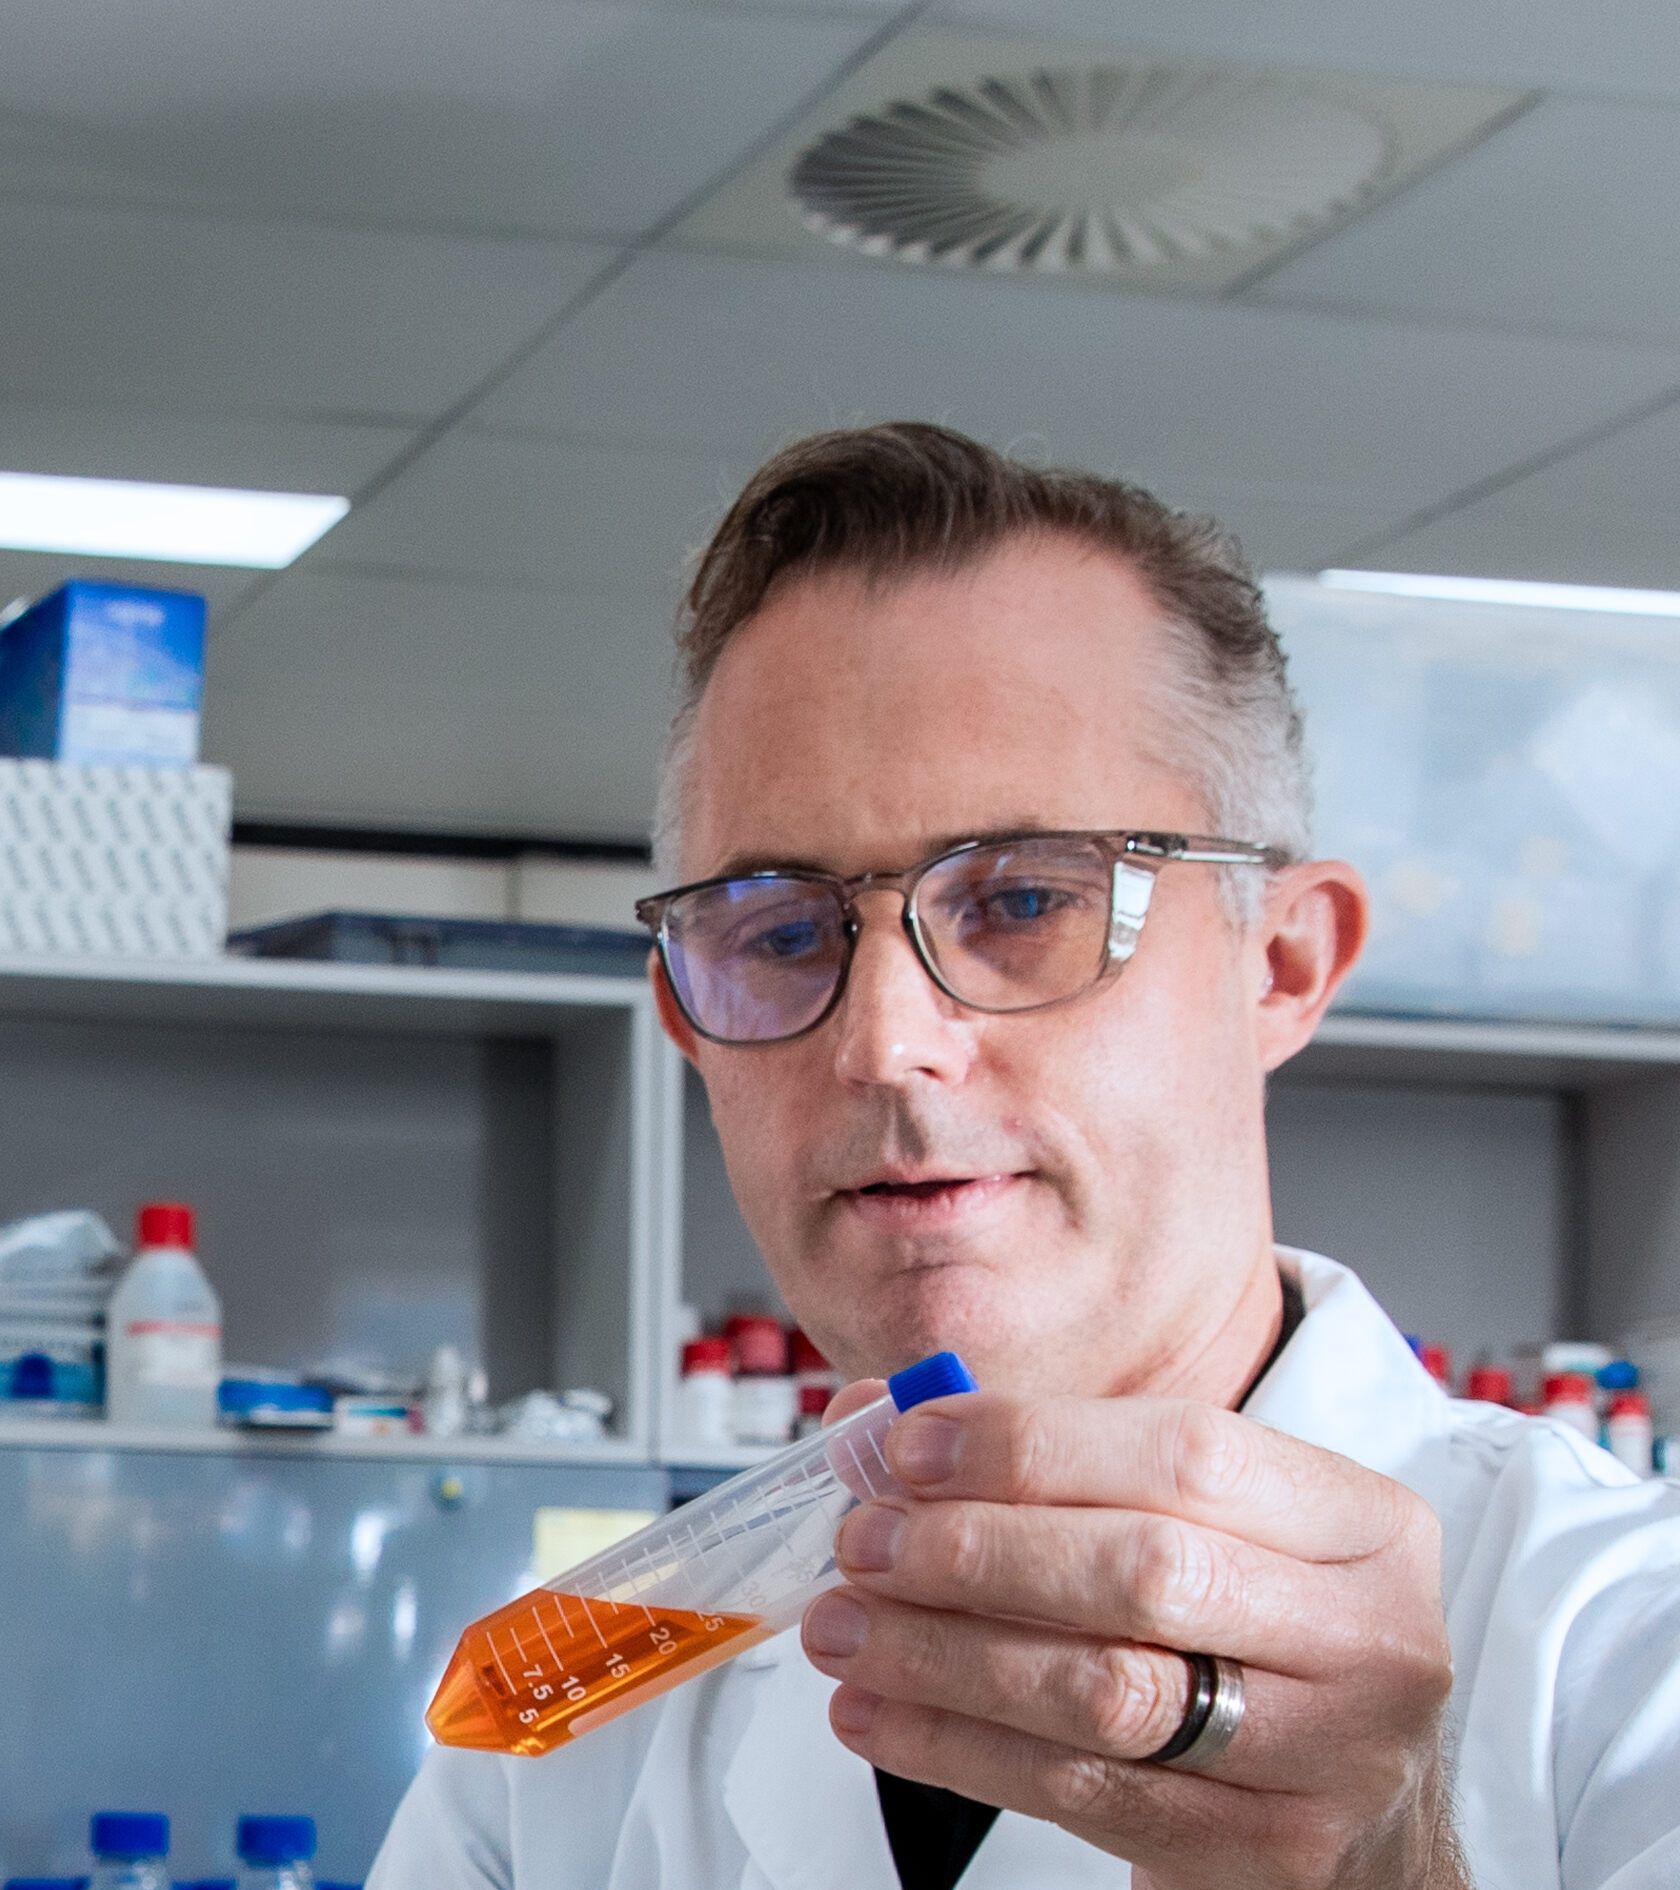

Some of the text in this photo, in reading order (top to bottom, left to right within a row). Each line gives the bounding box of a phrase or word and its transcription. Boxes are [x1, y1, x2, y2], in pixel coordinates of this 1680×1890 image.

[649, 1627, 678, 1655] 20
[605, 1652, 632, 1679] 15
[522, 1663, 554, 1700] 7.5
[561, 1675, 587, 1701] 10
[519, 1707, 539, 1725] 5
